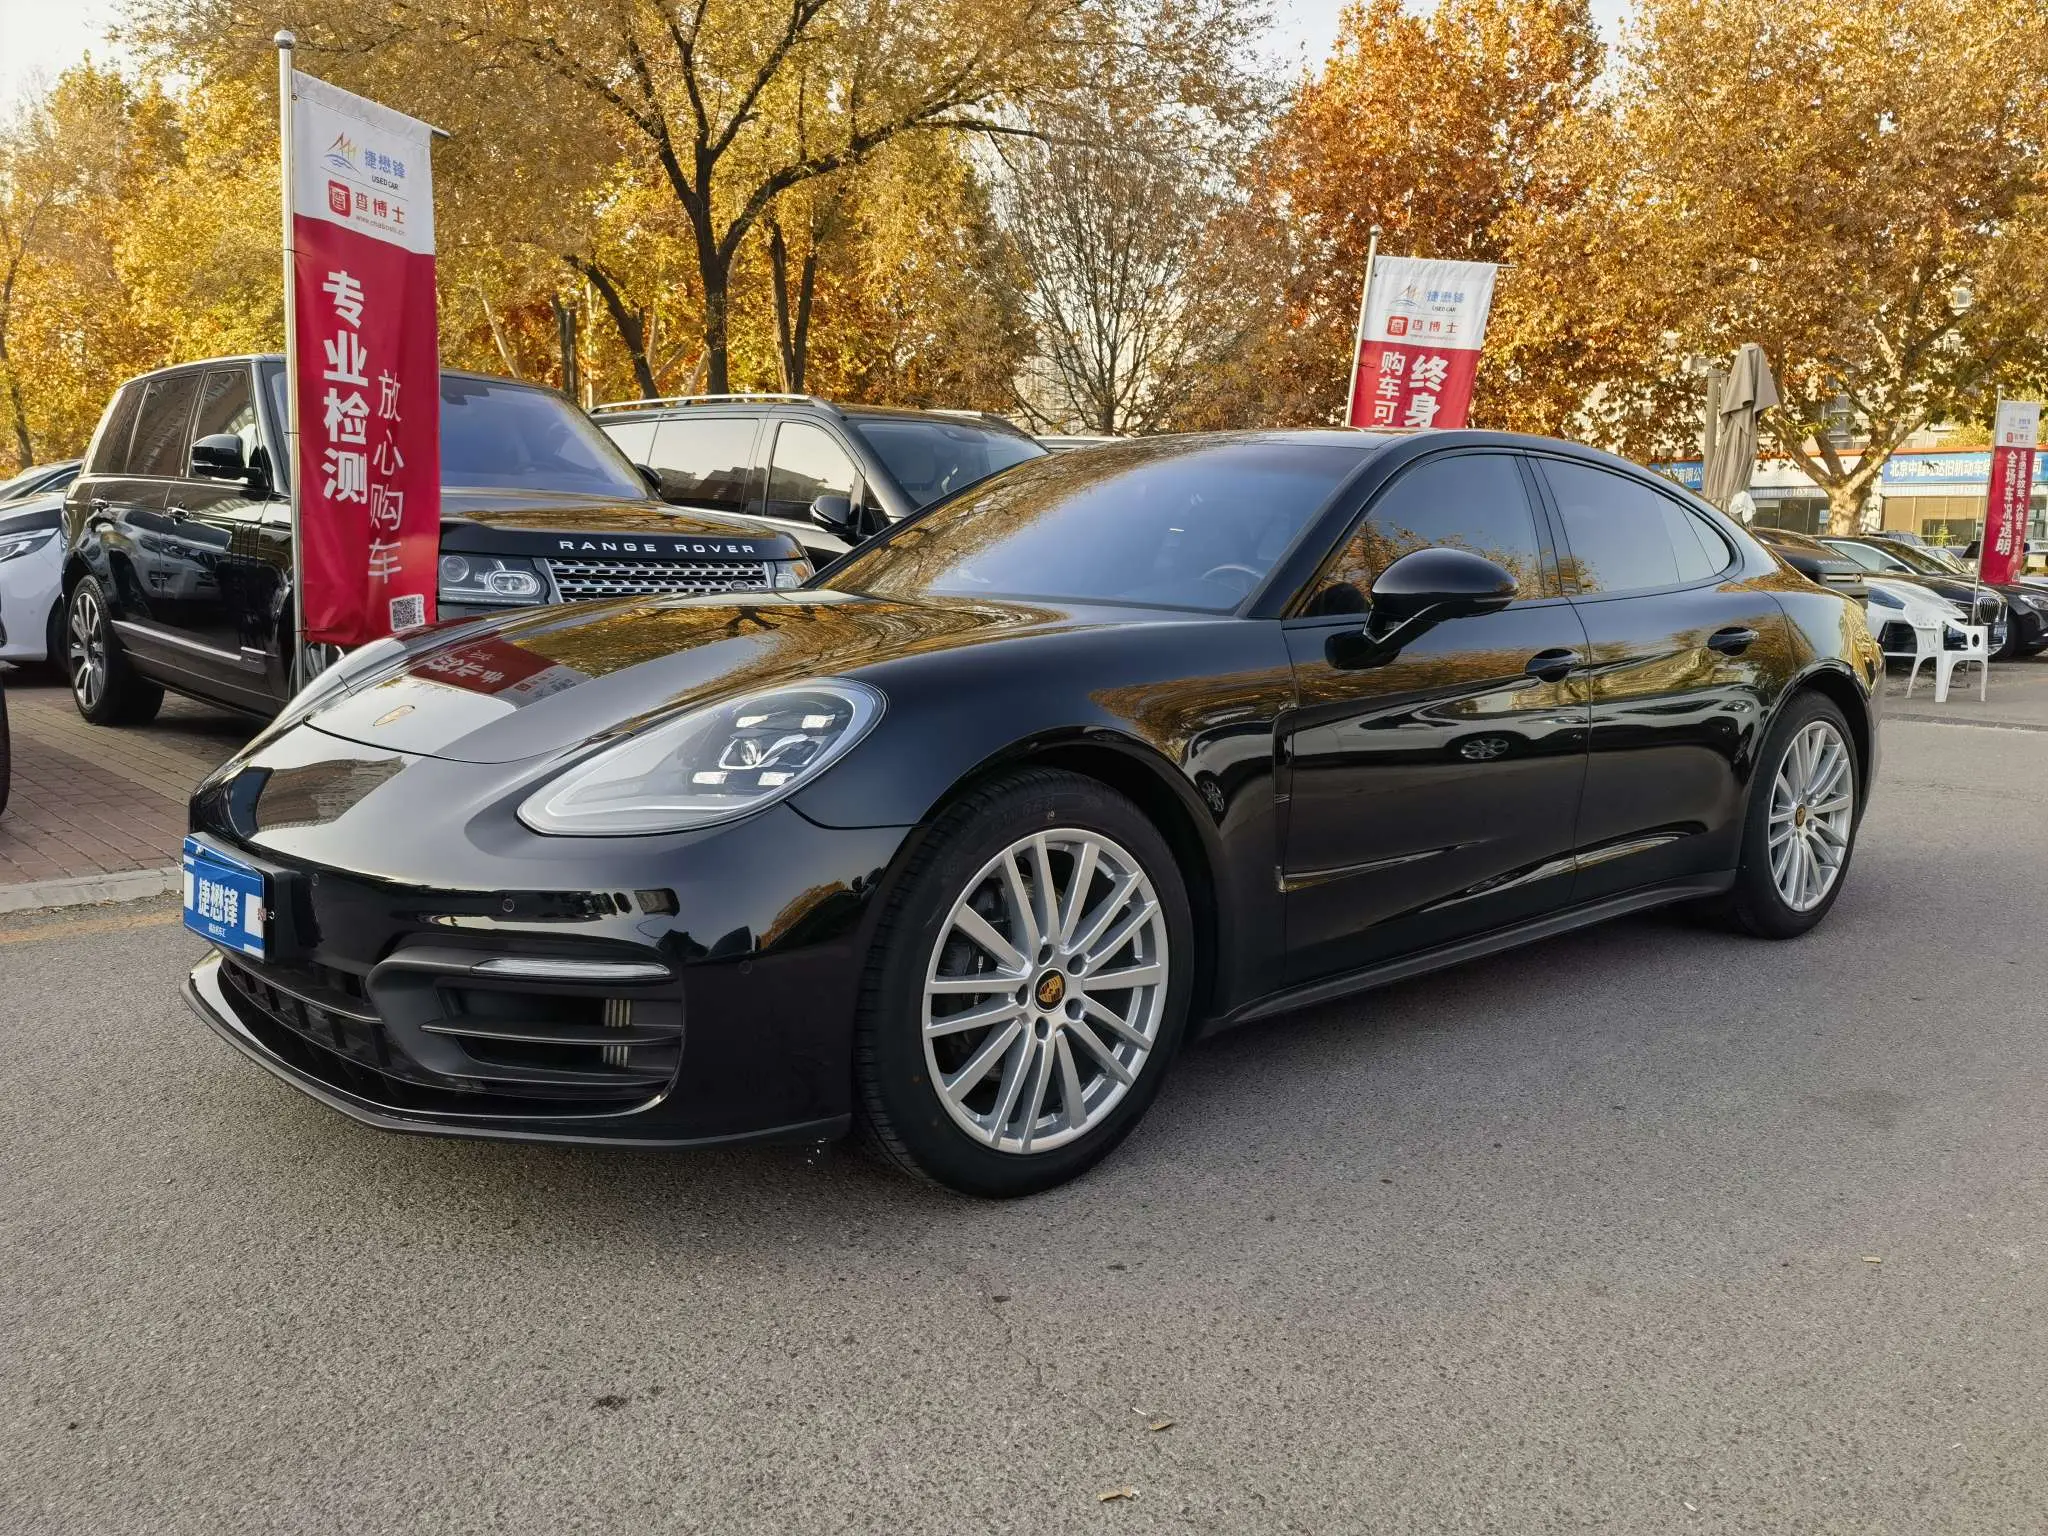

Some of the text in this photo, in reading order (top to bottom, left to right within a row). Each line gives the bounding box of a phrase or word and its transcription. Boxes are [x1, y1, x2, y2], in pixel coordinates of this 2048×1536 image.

[355, 191, 405, 225] 查博士
[371, 175, 399, 191] USED CAR
[322, 269, 370, 505] 专业检测
[1373, 351, 1407, 427] 购车可
[1404, 354, 1449, 429] 终身
[367, 368, 406, 585] 放心购车
[1995, 450, 2018, 556] 全场车况透明
[558, 540, 755, 554] RANGE ROVER
[197, 877, 239, 928] 捷懋锋
